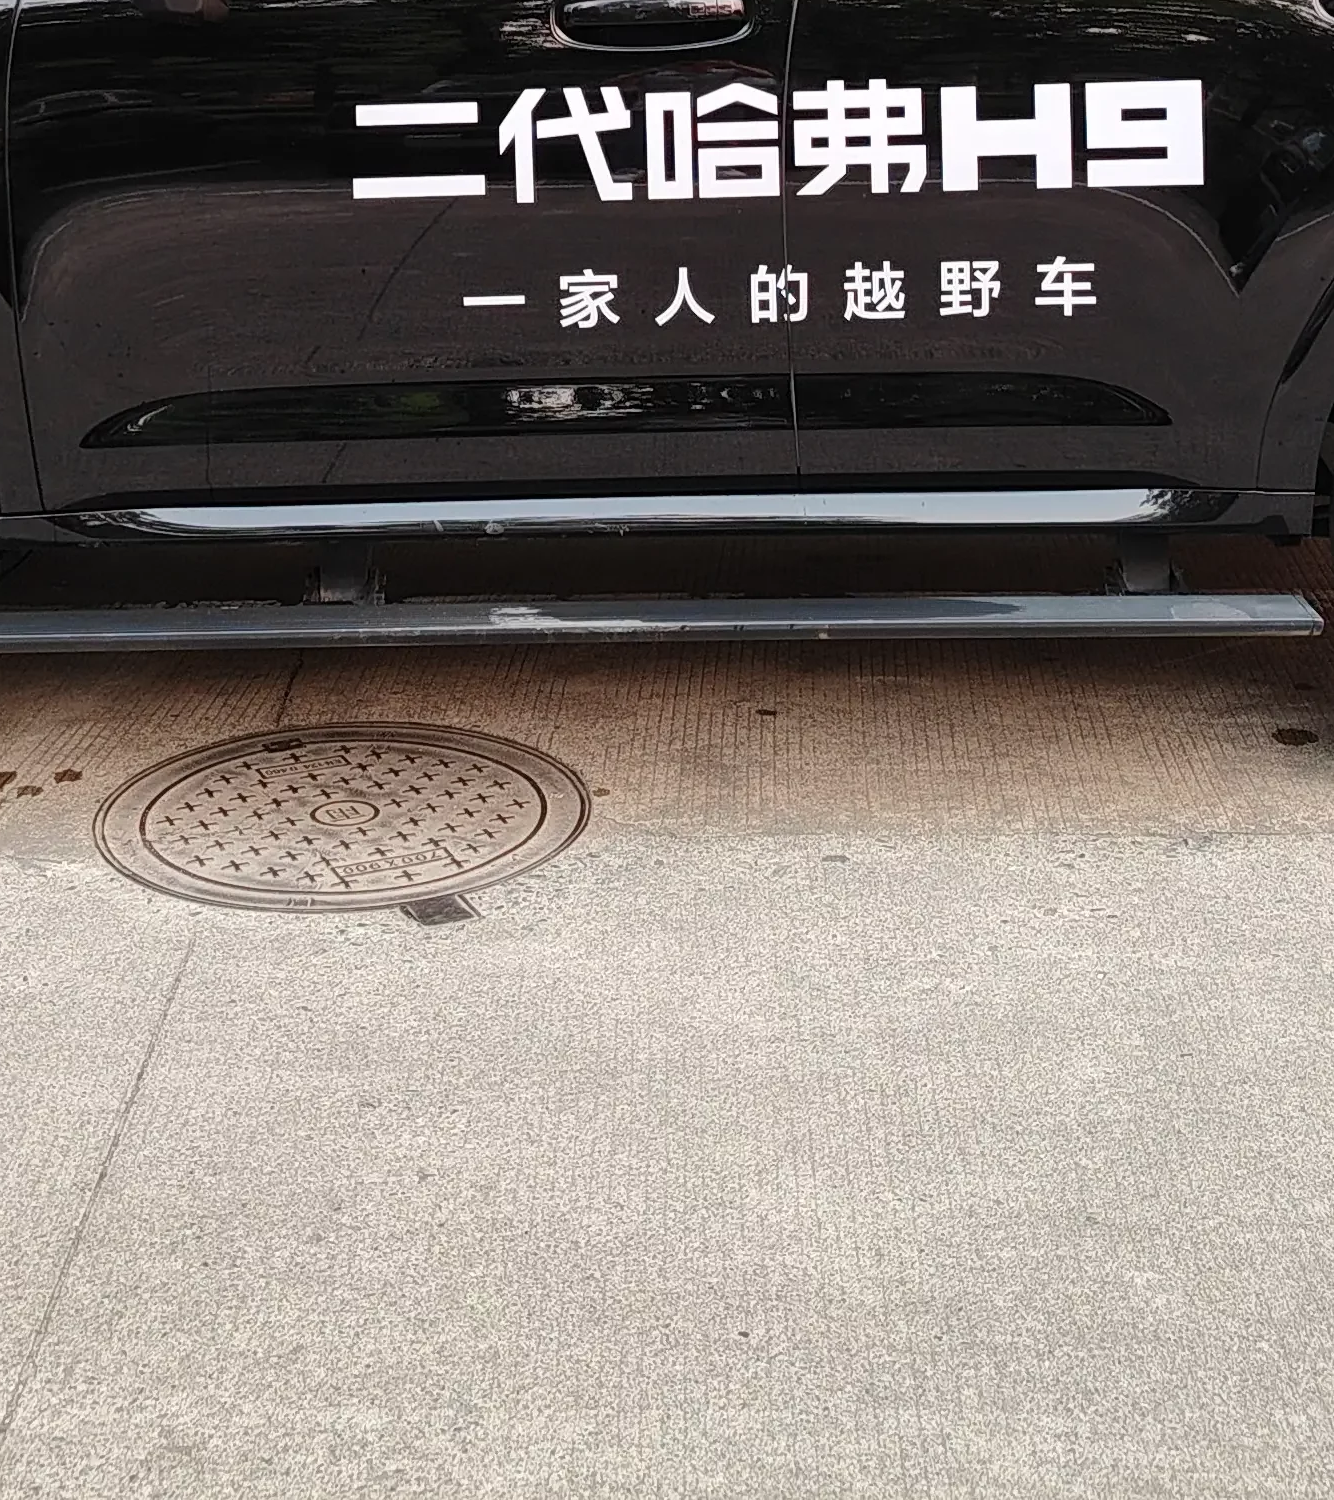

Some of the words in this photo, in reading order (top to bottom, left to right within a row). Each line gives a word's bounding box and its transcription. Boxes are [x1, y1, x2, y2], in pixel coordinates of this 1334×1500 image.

[353, 78, 1205, 204] 二代哈弗H9
[462, 255, 1097, 329] 一家人的越野车
